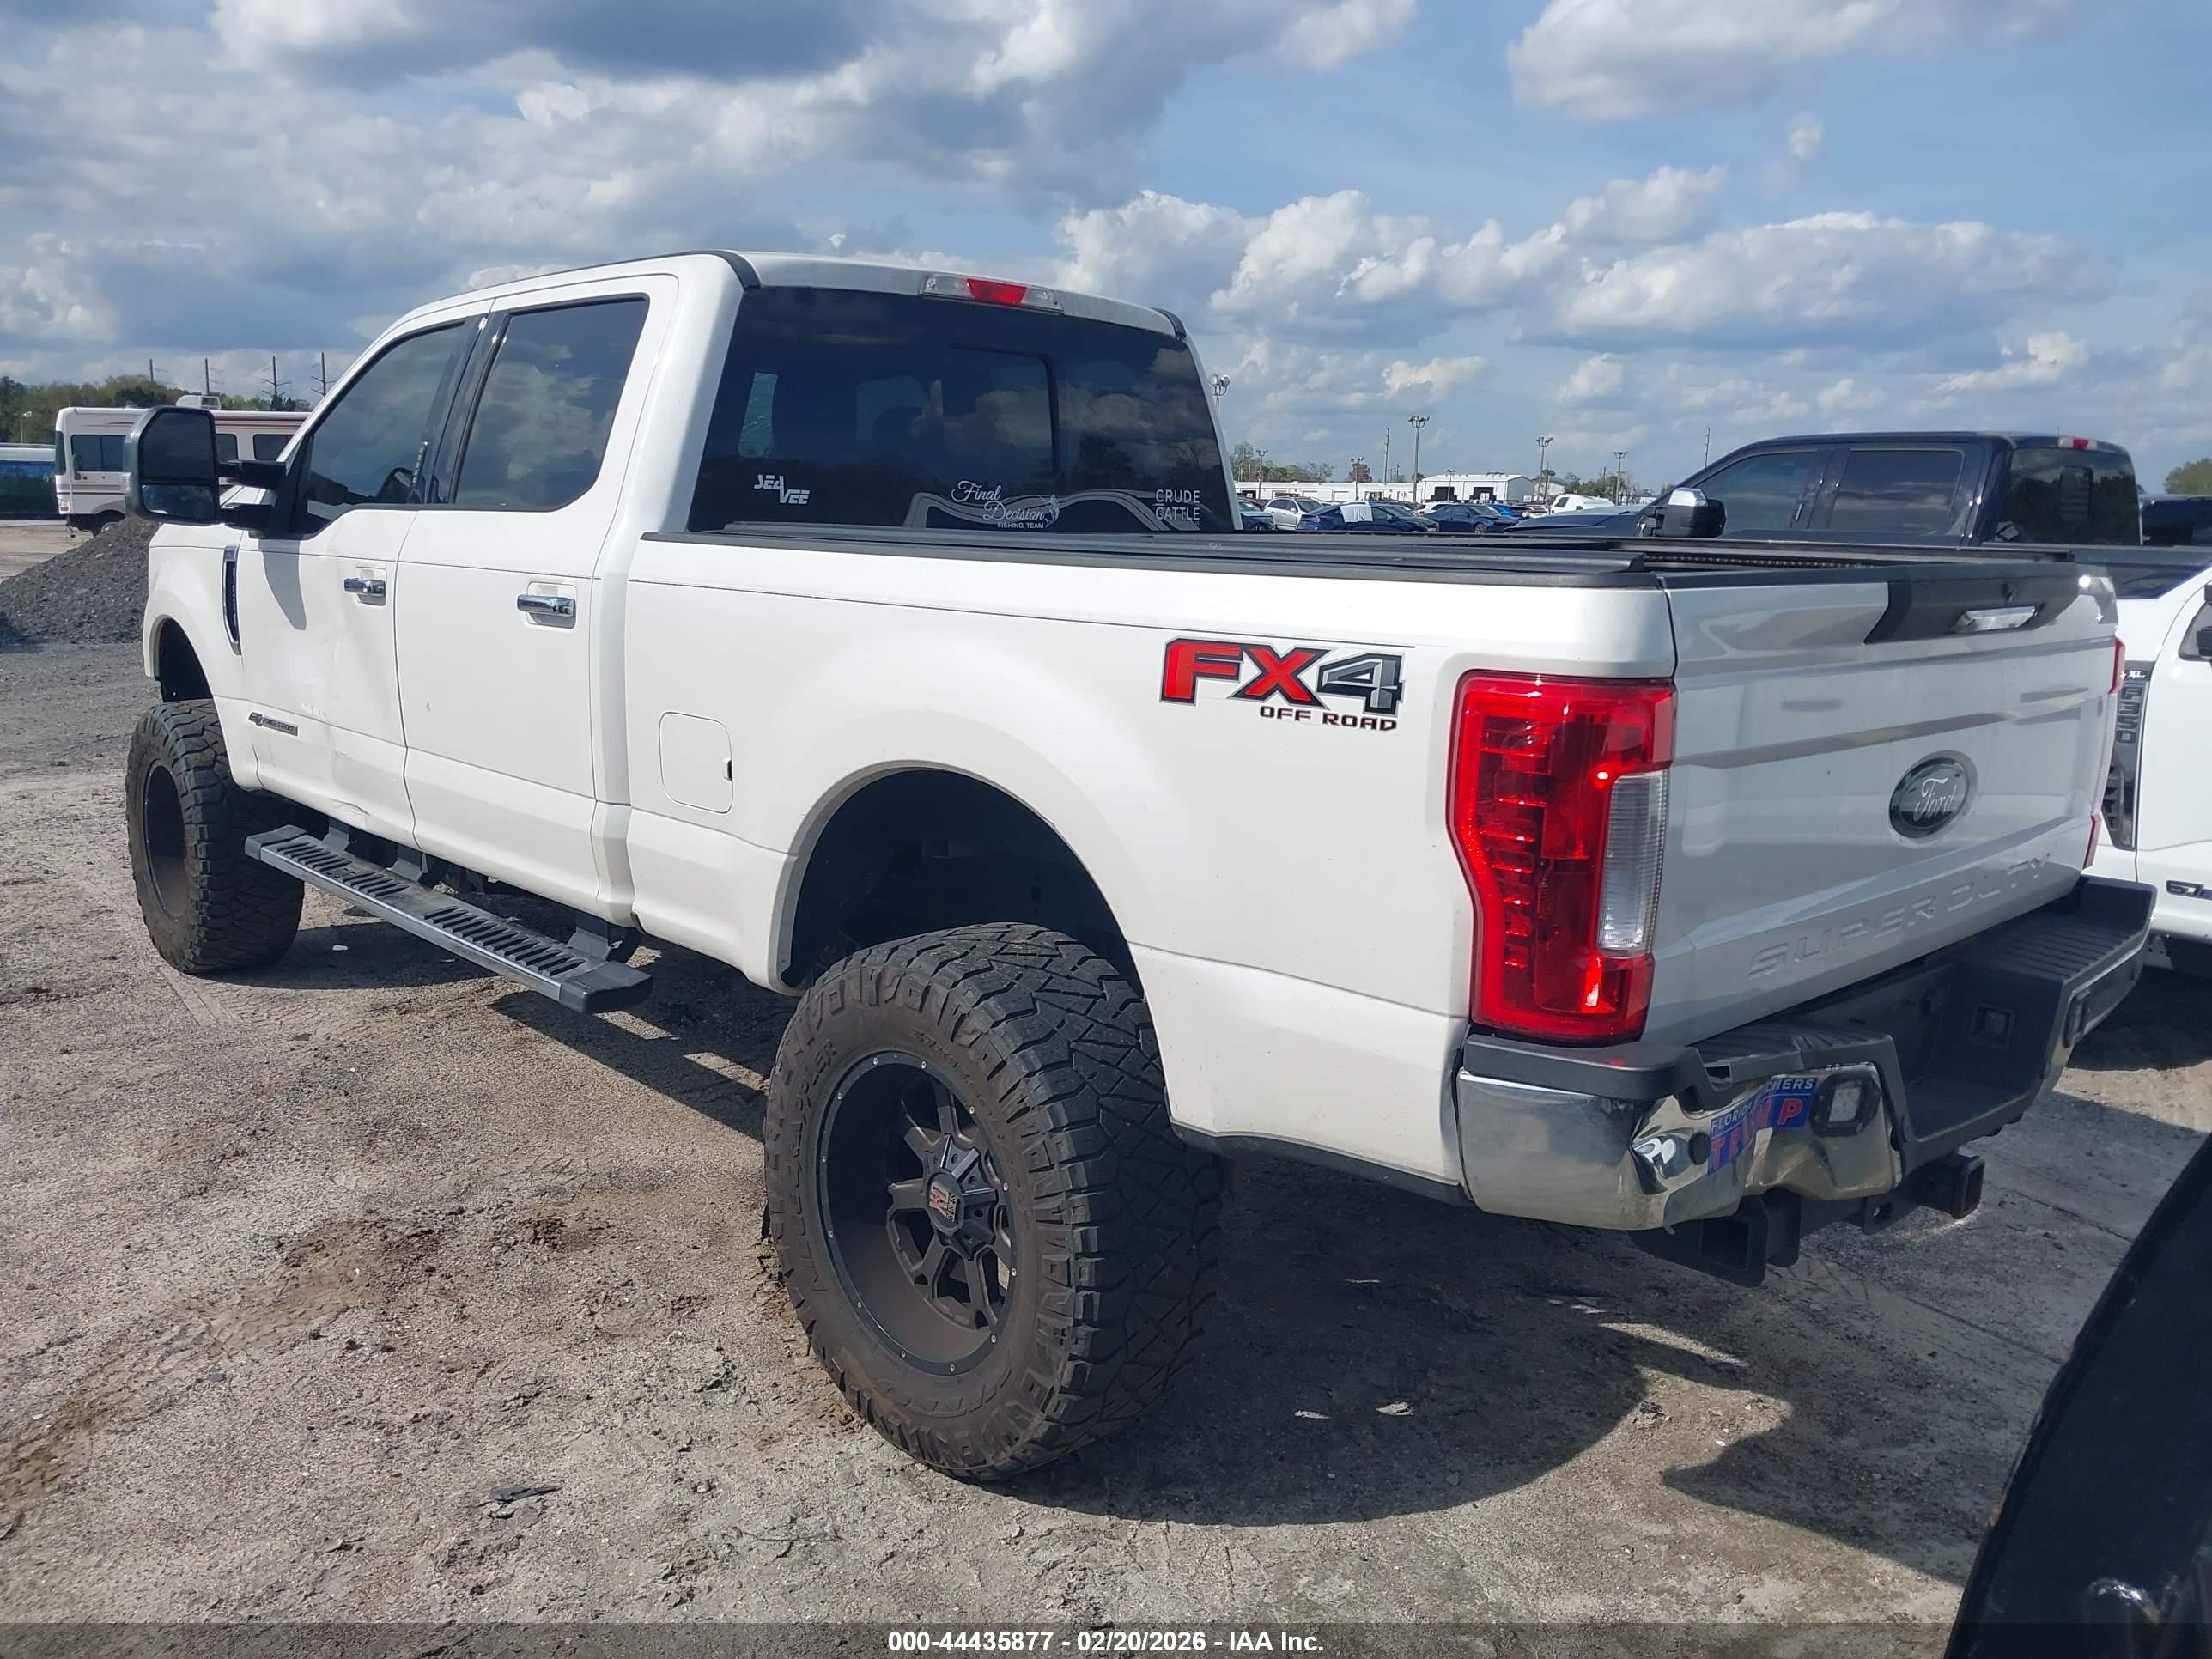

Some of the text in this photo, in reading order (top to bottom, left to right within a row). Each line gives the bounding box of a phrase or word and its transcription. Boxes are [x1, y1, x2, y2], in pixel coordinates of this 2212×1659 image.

[754, 474, 785, 490] SEA
[951, 480, 1002, 502] Final
[779, 489, 811, 505] VEE
[1156, 489, 1200, 504] CRUDE
[982, 500, 1045, 520] Decision
[1155, 507, 1200, 521] CATTLE
[1159, 637, 1407, 716] FX4
[1259, 705, 1398, 732] OFF ROAD
[1913, 776, 1958, 822] Ford
[1747, 894, 1937, 981] SUPER
